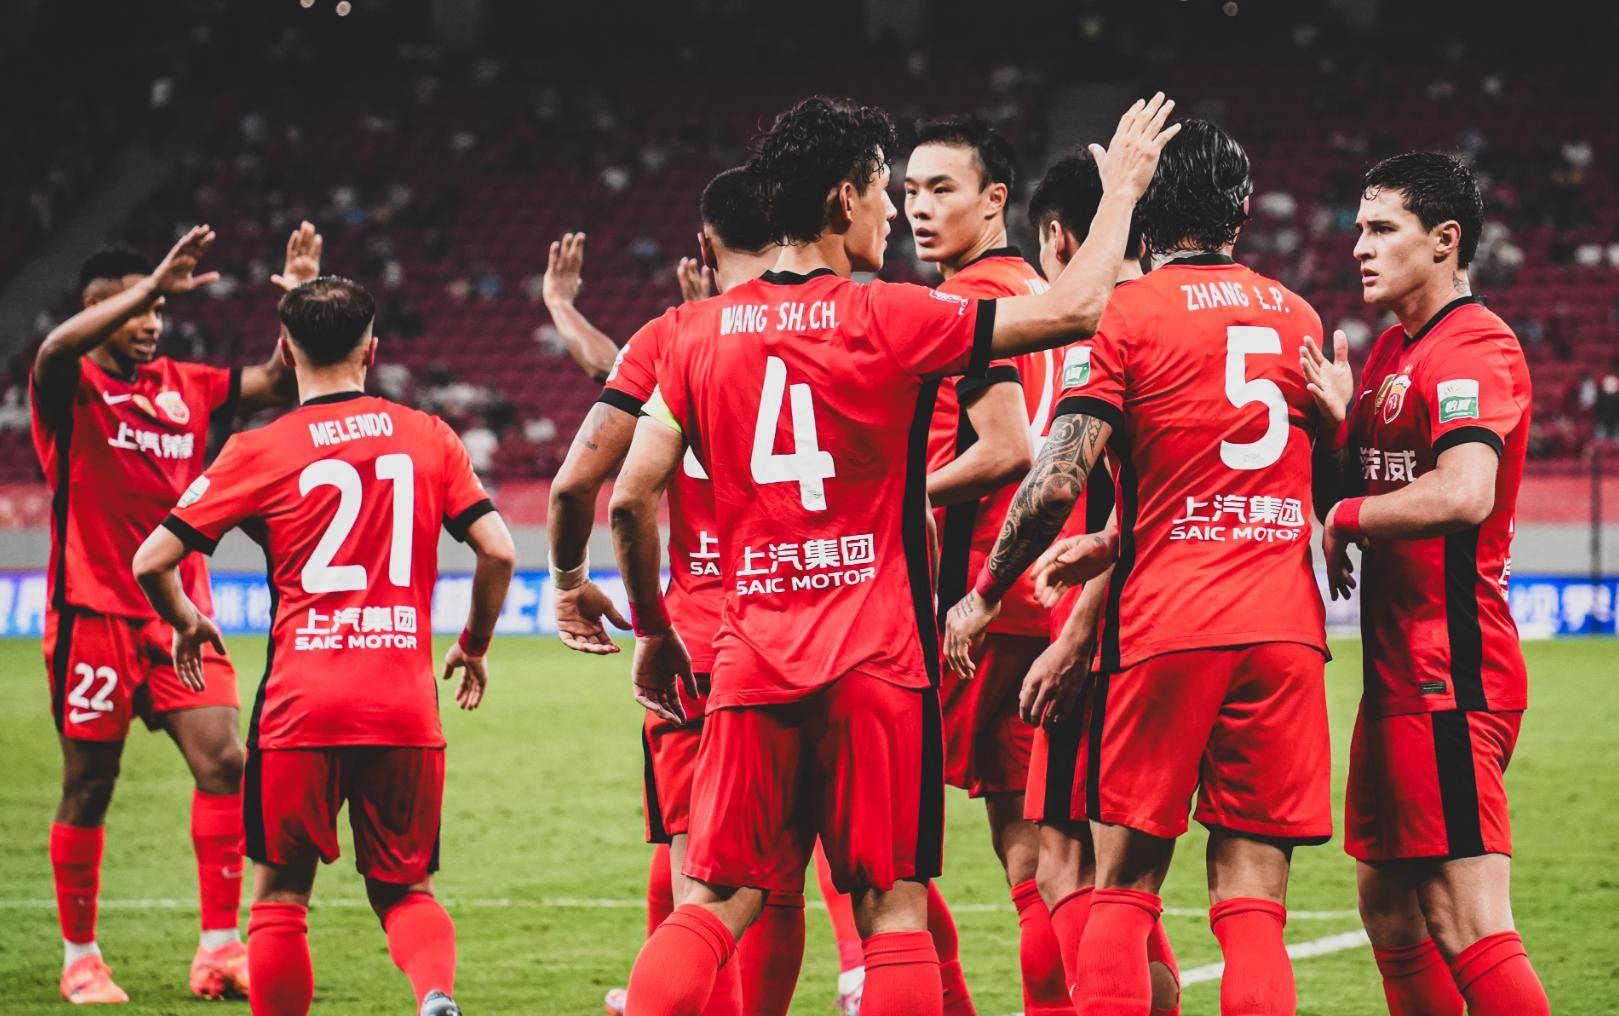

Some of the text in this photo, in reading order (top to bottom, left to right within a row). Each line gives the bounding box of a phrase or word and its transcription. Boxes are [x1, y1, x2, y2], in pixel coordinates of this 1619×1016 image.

[1180, 282, 1290, 313] ZHANG L.P.
[721, 304, 769, 336] WANG
[1219, 325, 1290, 471] 5
[308, 411, 395, 449] MELENDO
[750, 356, 836, 512] 4
[298, 453, 415, 594] 21
[1172, 494, 1306, 527] 上汽集团
[1169, 526, 1226, 542] SAIC
[736, 533, 876, 577] 上汽集团
[736, 567, 876, 596] SAIC MOTOR
[295, 606, 417, 634] 上汽集团
[295, 634, 417, 651] SAIC MOTOR
[67, 662, 118, 712] 22
